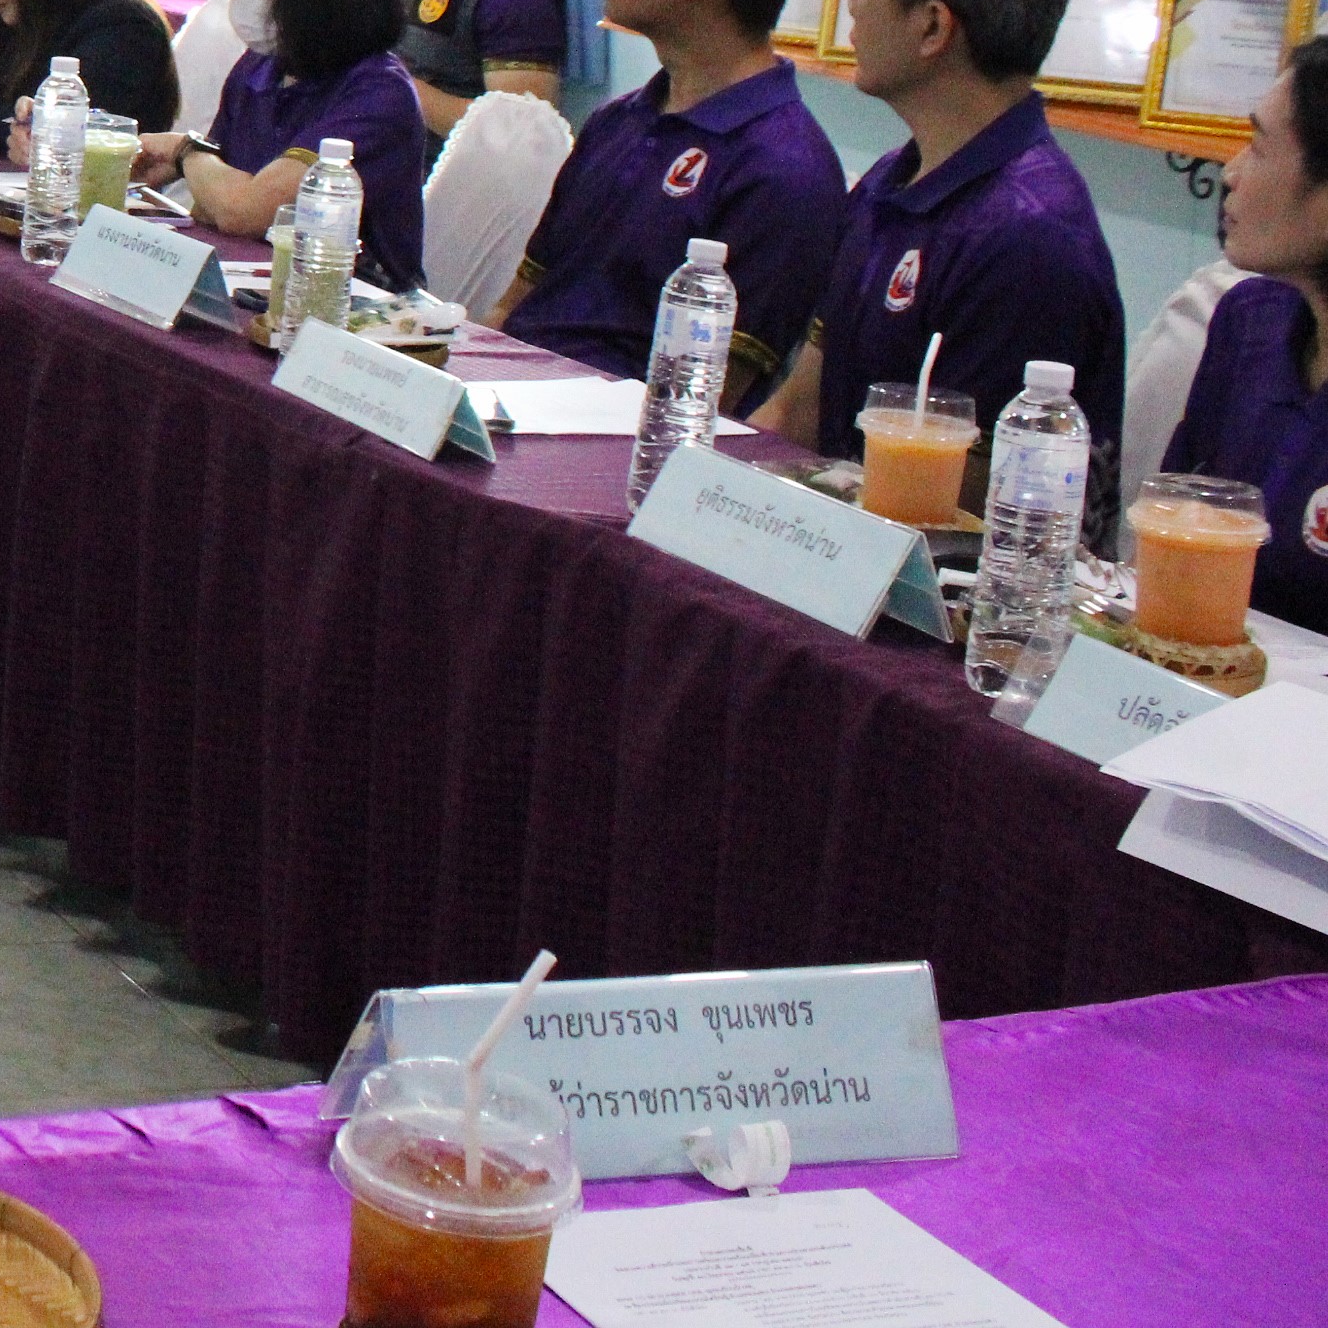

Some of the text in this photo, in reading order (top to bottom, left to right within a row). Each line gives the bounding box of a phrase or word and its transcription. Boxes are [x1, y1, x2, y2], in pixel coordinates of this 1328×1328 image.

[694, 485, 843, 561] ยุติธรรมจังหวัดน่าน
[524, 999, 814, 1044] นายบรรจง ขุนเพชร
